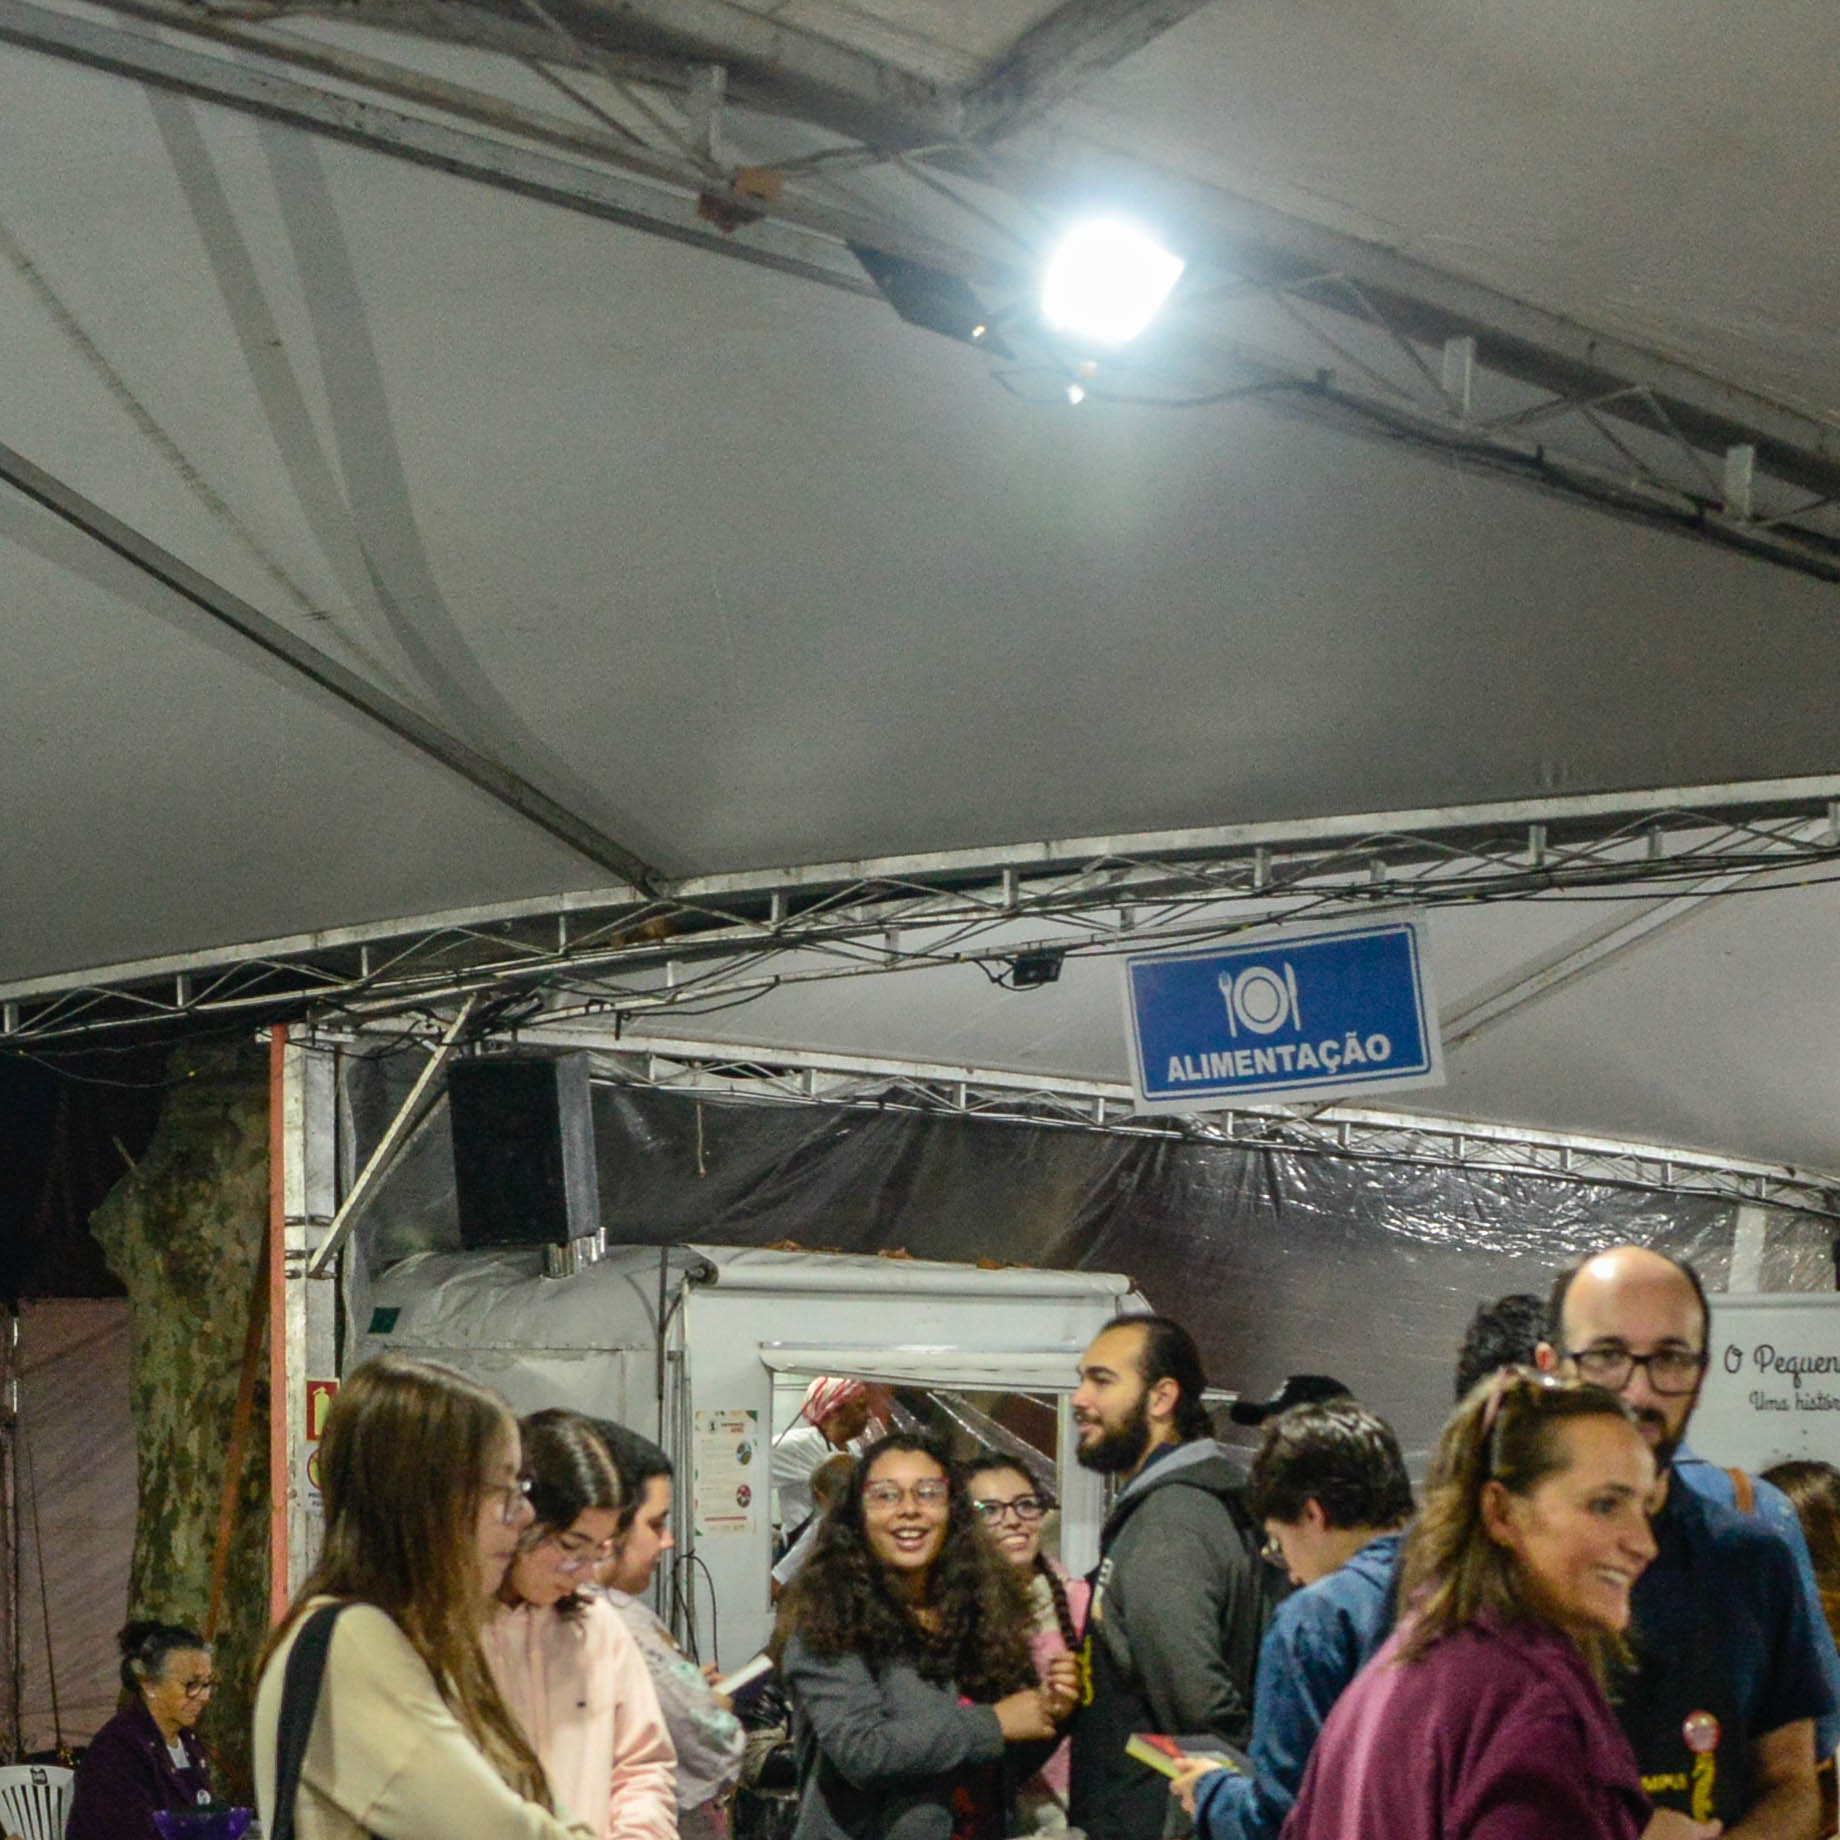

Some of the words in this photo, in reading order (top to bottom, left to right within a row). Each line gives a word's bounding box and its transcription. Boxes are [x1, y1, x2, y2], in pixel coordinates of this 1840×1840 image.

[1167, 1031, 1392, 1083] ALIMENTAÇÃO
[1724, 1344, 1742, 1374] O
[1749, 1390, 1790, 1411] Uma
